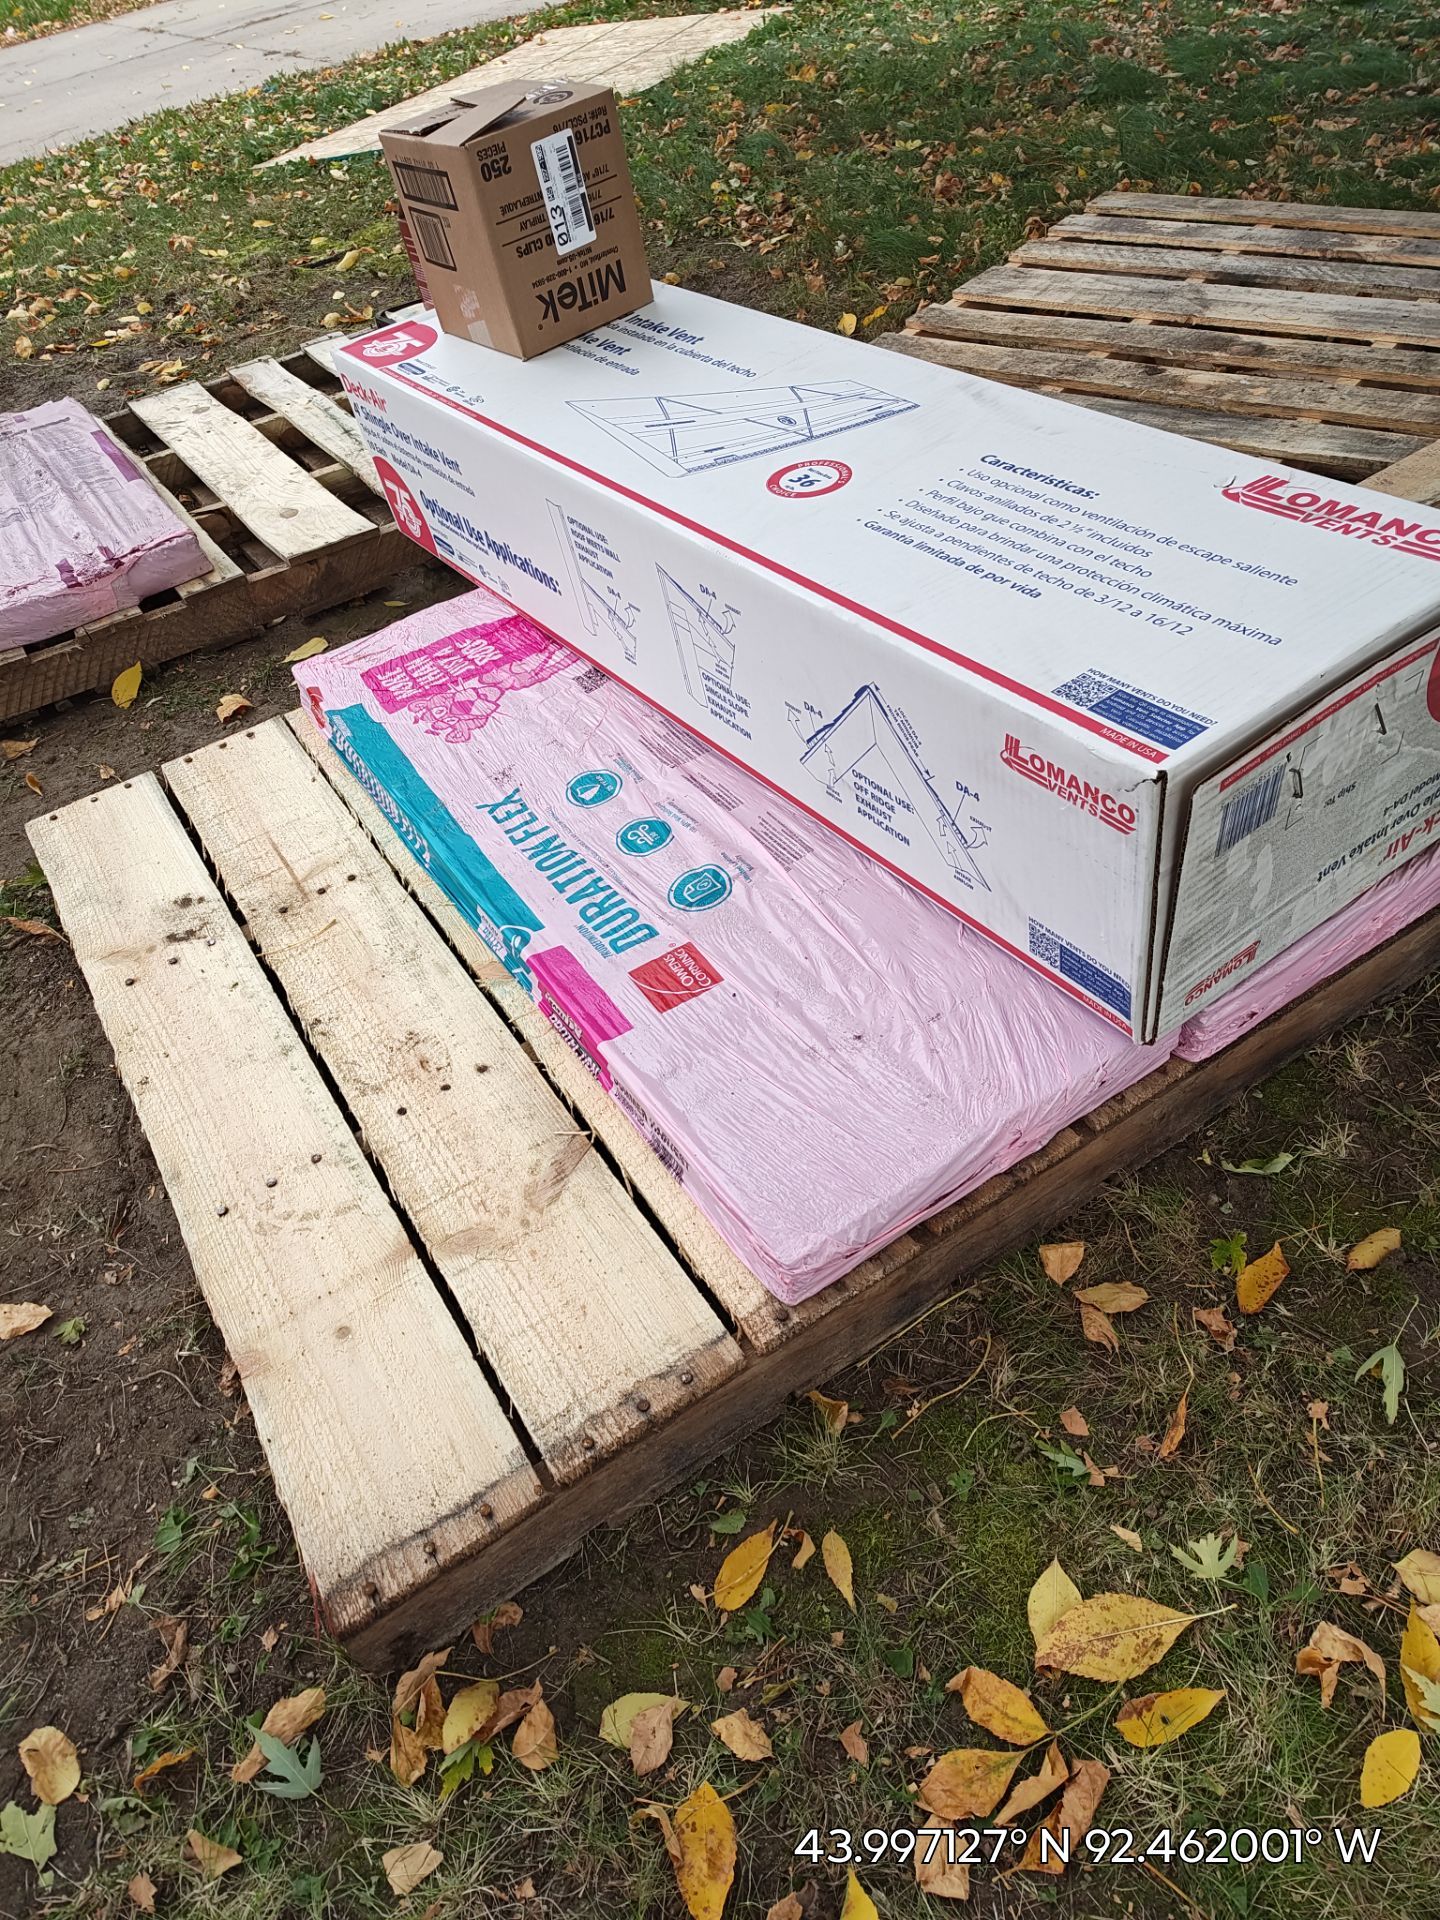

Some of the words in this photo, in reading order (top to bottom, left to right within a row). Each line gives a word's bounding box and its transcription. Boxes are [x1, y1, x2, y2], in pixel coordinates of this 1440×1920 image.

[476, 141, 507, 162] PIECES
[480, 154, 512, 183] 250
[519, 213, 547, 232] TRIPLAY
[515, 238, 543, 258] CLIPS
[535, 259, 627, 323] MiTek
[596, 338, 632, 356] Vent
[625, 314, 669, 334] Intake
[667, 327, 705, 346] Vent
[594, 355, 607, 364] de
[605, 359, 641, 376] entrada
[617, 324, 655, 343] instalado
[653, 338, 668, 347] en
[666, 342, 676, 351] la
[675, 346, 713, 363] cubierta
[711, 357, 729, 368] del
[728, 363, 757, 378] techo
[390, 422, 412, 446] Over
[410, 433, 441, 462] Intake
[438, 449, 463, 476] Vent
[769, 484, 798, 497] CHOICE
[788, 474, 821, 487] 36
[980, 454, 1100, 500] Características:
[946, 479, 986, 499] Clavos
[983, 492, 1043, 519] anillados
[1039, 511, 1061, 526] de
[1056, 519, 1072, 530] 2
[1087, 530, 1153, 559] incluidos
[967, 468, 990, 482] Uso
[990, 477, 1048, 501] opcional
[1042, 497, 1081, 514] como
[1081, 508, 1156, 540] ventilación
[1156, 534, 1178, 547] de
[1178, 542, 1233, 568] escape
[1231, 560, 1298, 587] saliente
[1242, 475, 1440, 545] LOMANC
[419, 489, 465, 533] Optional
[463, 516, 486, 546] Use
[484, 530, 562, 596] Applications:
[925, 488, 965, 509] Perfil
[959, 500, 985, 518] bajo
[1008, 521, 1067, 547] combina
[1066, 542, 1095, 557] con
[1093, 552, 1109, 563] el
[1108, 558, 1153, 579] techo
[1300, 512, 1398, 546] VENTS
[863, 519, 915, 547] Garantía
[912, 540, 967, 568] limitada
[964, 563, 986, 576] de
[980, 573, 1012, 587] por
[1009, 582, 1043, 600] vida
[883, 509, 903, 523] Se
[898, 516, 935, 535] ajusta
[934, 529, 945, 538] a
[940, 533, 1016, 567] pendientes
[1013, 561, 1034, 574] de
[1032, 568, 1076, 592] techo
[1073, 585, 1096, 599] de
[1093, 593, 1134, 613] 3/12
[1129, 608, 1143, 618] a
[1146, 612, 1194, 636] 16/12
[904, 499, 961, 525] Diseñado
[956, 521, 992, 541] para
[987, 530, 1038, 556] brindar
[1034, 550, 1065, 566] una
[1061, 558, 1141, 595] protección
[1140, 590, 1213, 621] climática
[1211, 615, 1283, 646] máxima
[701, 671, 735, 698] OPTIONAL
[735, 693, 751, 709] USE:
[704, 683, 727, 703] SINGLE
[728, 698, 750, 718] SLOPE
[1087, 667, 1109, 680] HOW
[1107, 675, 1132, 692] MANY
[1130, 686, 1157, 701] VENTS
[1154, 697, 1171, 707] DO
[1170, 703, 1190, 716] YOU
[1188, 711, 1218, 726] NEED?
[707, 696, 737, 720] EXHAUST
[710, 708, 752, 740] APPLICATION
[803, 702, 823, 718] DA-4
[1100, 727, 1128, 745] MADE
[1126, 739, 1138, 750] IN
[1137, 744, 1157, 759] USA
[851, 769, 894, 801] OPTIONAL
[894, 796, 915, 815] USE:
[955, 780, 980, 802] DA-4
[1005, 733, 1136, 824] LOMANCO
[1335, 780, 1358, 798] Ship
[853, 781, 869, 796] OFF
[870, 792, 896, 815] RIDGE
[855, 794, 893, 823] EXHAUST
[1047, 779, 1098, 817] VENTS
[475, 787, 550, 846] FLEX
[857, 807, 910, 846] APPLICATION
[1390, 803, 1420, 829] Over
[1348, 823, 1390, 859] Intake
[1316, 853, 1347, 883] Vent
[521, 833, 660, 955] DURATION
[1028, 916, 1045, 930] HOW
[1045, 926, 1064, 943] MANY
[1065, 939, 1086, 957] VENTS
[1086, 953, 1098, 965] DO
[1099, 961, 1113, 975] YOU
[663, 954, 695, 987] OWENS
[675, 947, 712, 987] CORNING
[1082, 995, 1103, 1014] MADE
[1103, 1010, 1112, 1020] IN
[1112, 1015, 1128, 1029] USA
